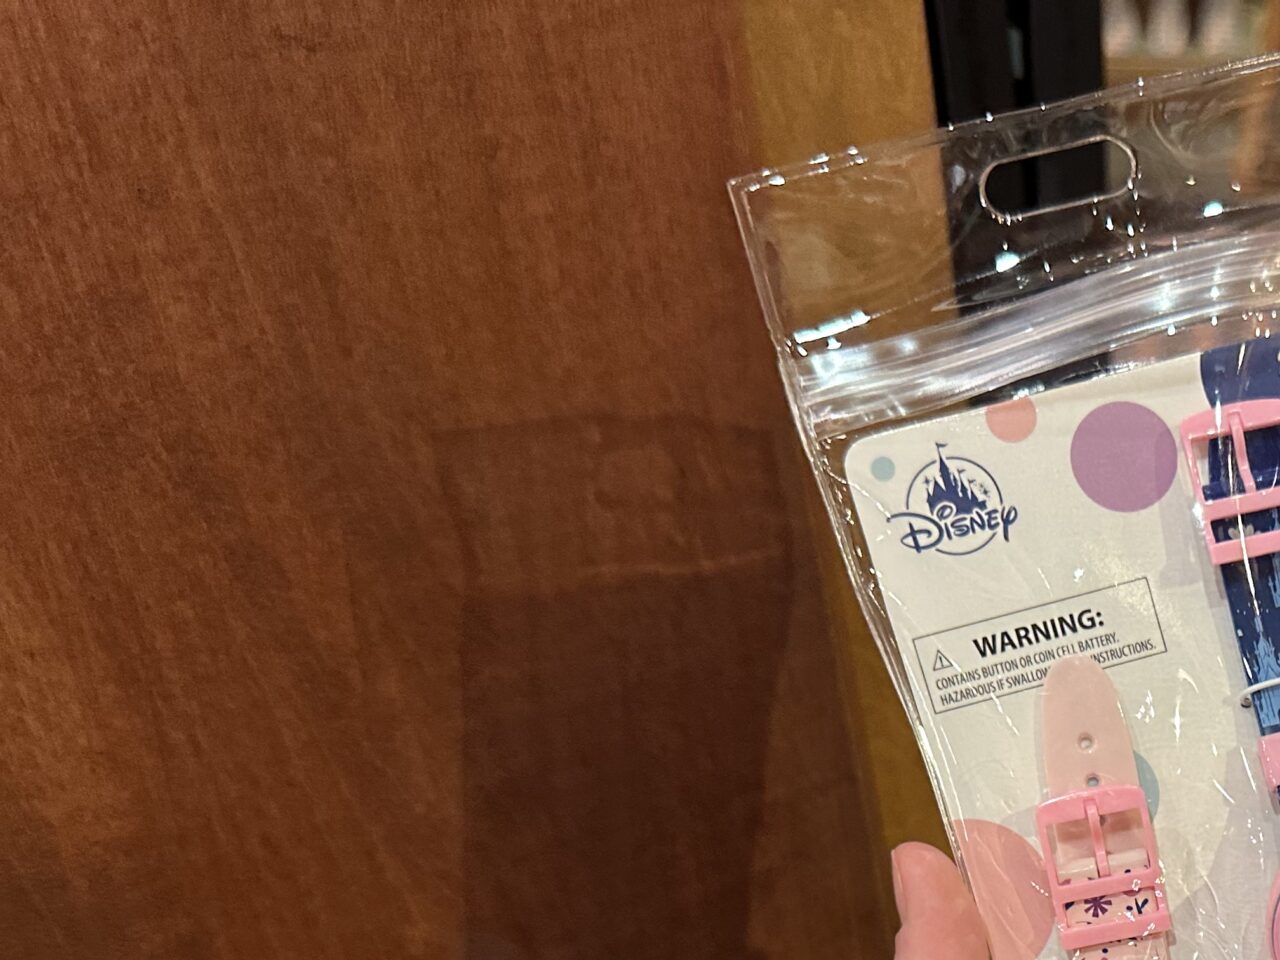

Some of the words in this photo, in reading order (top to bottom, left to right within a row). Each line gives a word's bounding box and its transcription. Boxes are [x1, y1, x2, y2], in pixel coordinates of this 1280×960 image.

[972, 608, 1105, 658] WARNING:
[935, 665, 981, 691] CONTAINS
[982, 656, 1019, 679] BUTTON
[1019, 653, 1033, 668] OR
[1033, 648, 1055, 666] COIN
[1079, 631, 1120, 653] BATTERY.
[940, 680, 997, 707] HAZARDOUS
[997, 677, 1005, 692] IF
